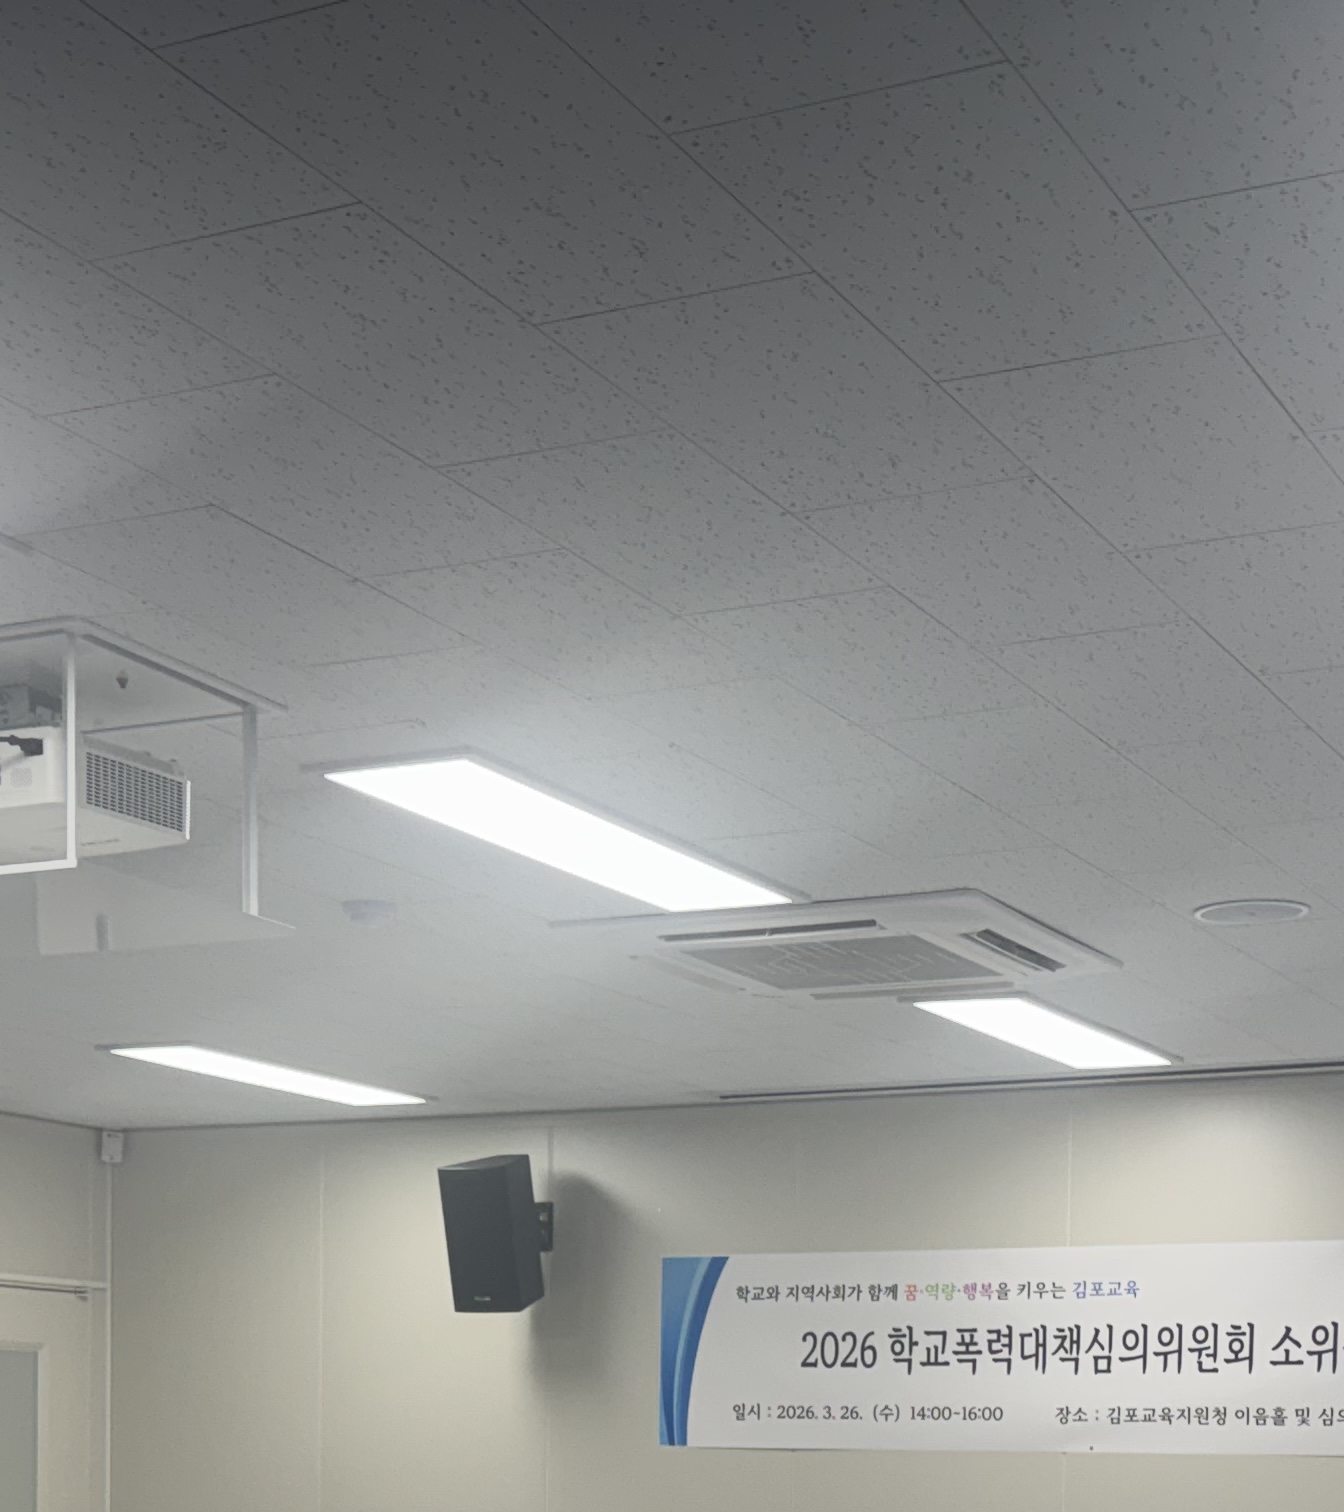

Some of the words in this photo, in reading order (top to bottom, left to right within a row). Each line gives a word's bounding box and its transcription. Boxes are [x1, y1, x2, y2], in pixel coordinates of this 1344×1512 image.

[735, 1284, 782, 1303] 학교와
[785, 1283, 864, 1303] 지역사회가
[867, 1283, 899, 1302] 함께
[1016, 1280, 1067, 1301] 키우는
[1071, 1279, 1141, 1299] 김포교육
[799, 1329, 878, 1370] 2026
[887, 1321, 1256, 1376] 학교폭력대책심의위원회
[776, 1404, 819, 1421] 2026.
[822, 1404, 837, 1421] 3.
[840, 1404, 864, 1421] 26.
[872, 1403, 901, 1423] (수)
[1106, 1405, 1228, 1426] 김포교육지원청
[1234, 1406, 1289, 1427] 이음홀
[1294, 1406, 1311, 1427] 및
